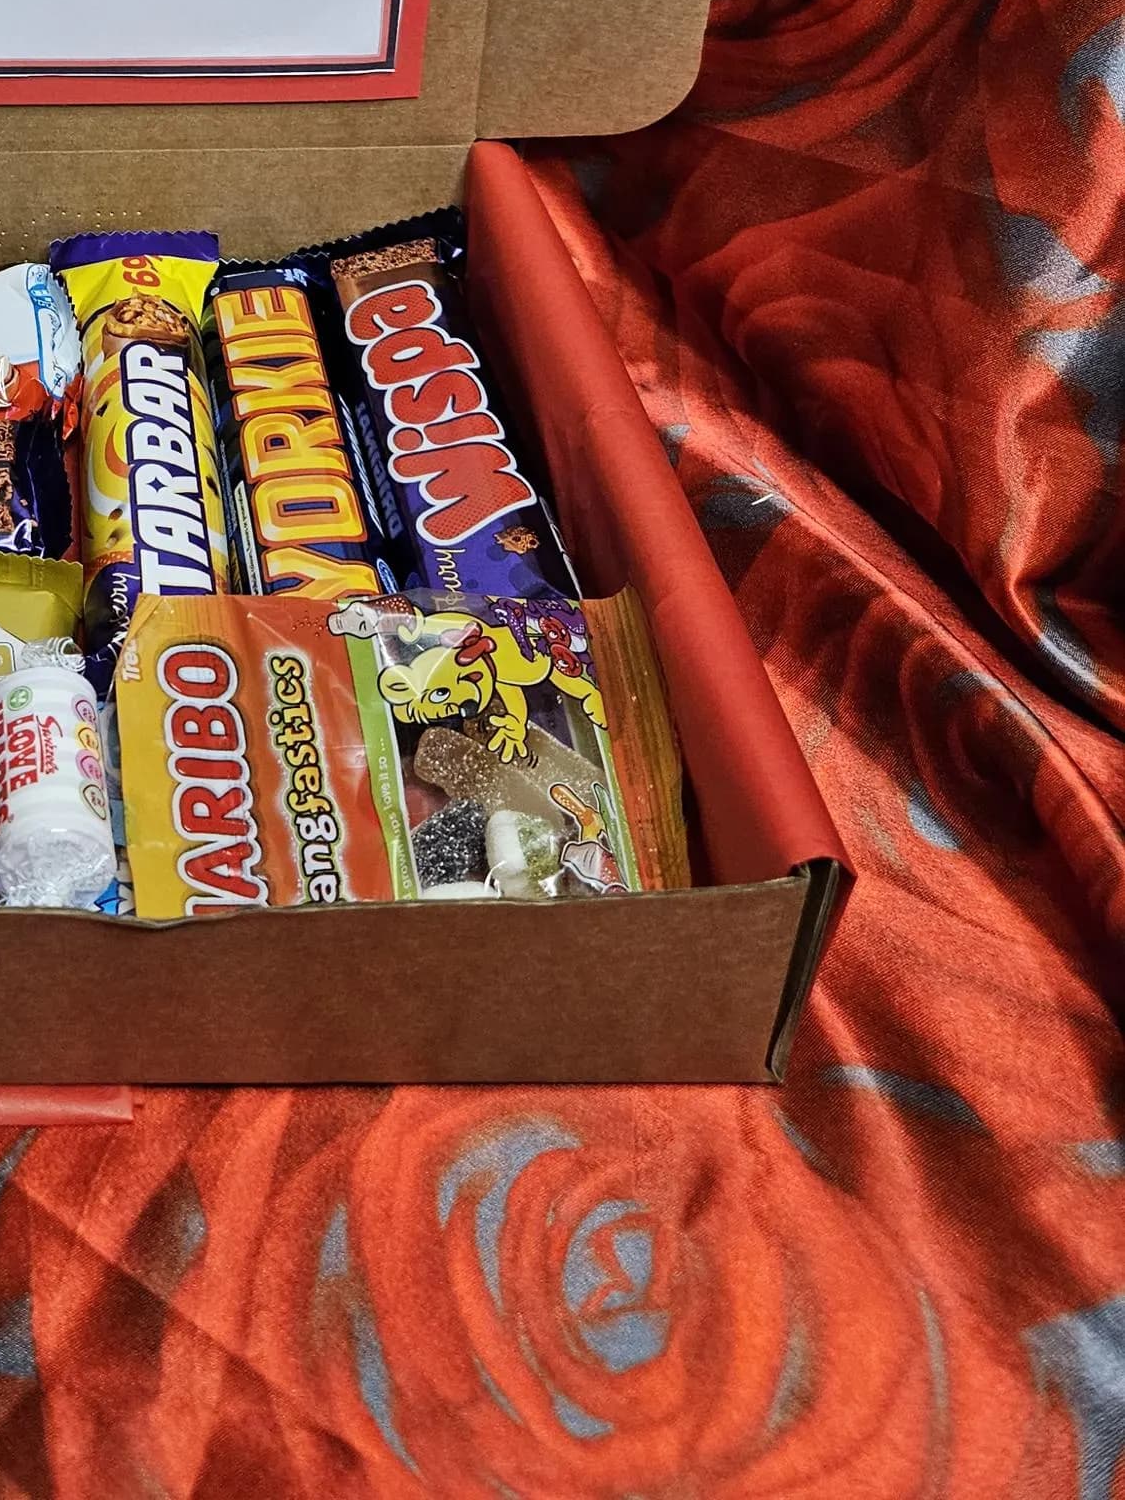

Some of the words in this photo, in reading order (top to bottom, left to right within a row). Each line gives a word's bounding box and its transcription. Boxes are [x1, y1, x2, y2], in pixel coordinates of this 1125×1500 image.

[123, 344, 215, 596] TARBAR
[6, 713, 39, 794] LOVE
[268, 655, 338, 903] angfastics
